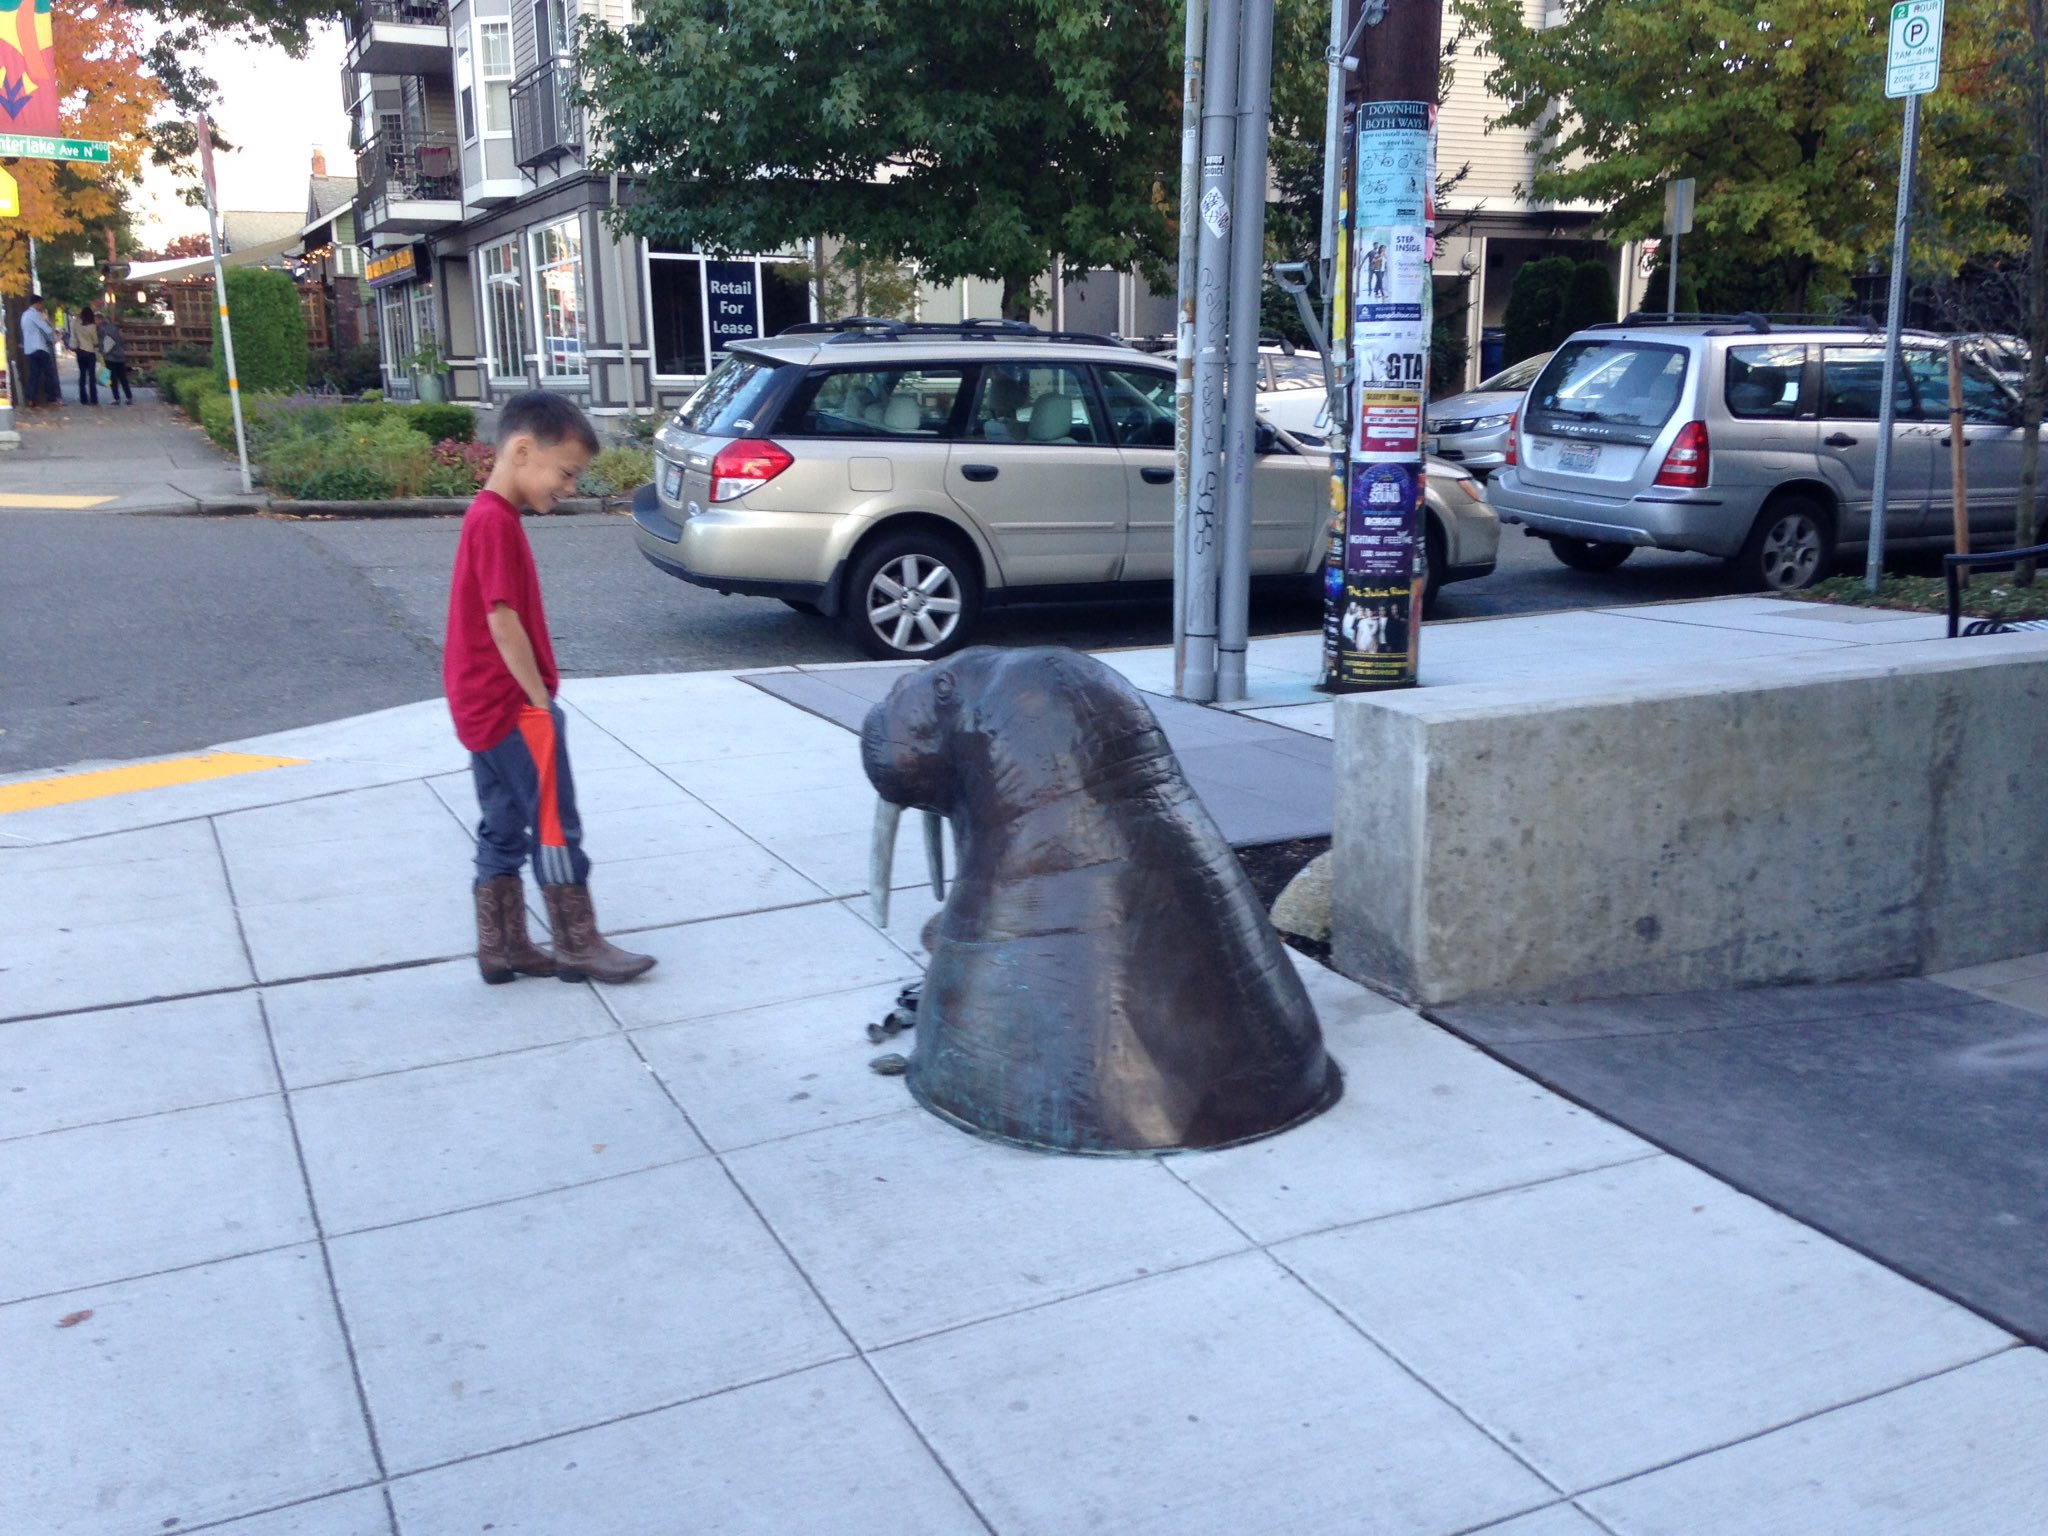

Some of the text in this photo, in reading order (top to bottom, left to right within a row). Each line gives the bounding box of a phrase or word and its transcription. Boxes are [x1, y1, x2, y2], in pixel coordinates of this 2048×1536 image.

[1898, 3, 1938, 18] 2 HOUR
[1910, 23, 1923, 42] P
[1894, 72, 1930, 84] ZONE 22
[1368, 104, 1425, 116] DOWNHILL
[1365, 119, 1396, 129] BOTH
[59, 145, 80, 157] Ave
[84, 146, 93, 158] N
[710, 280, 752, 295] Retail
[720, 301, 744, 314] For
[713, 320, 753, 334] Lease
[1386, 353, 1423, 380] GTA
[1552, 424, 1609, 435] SUBARU
